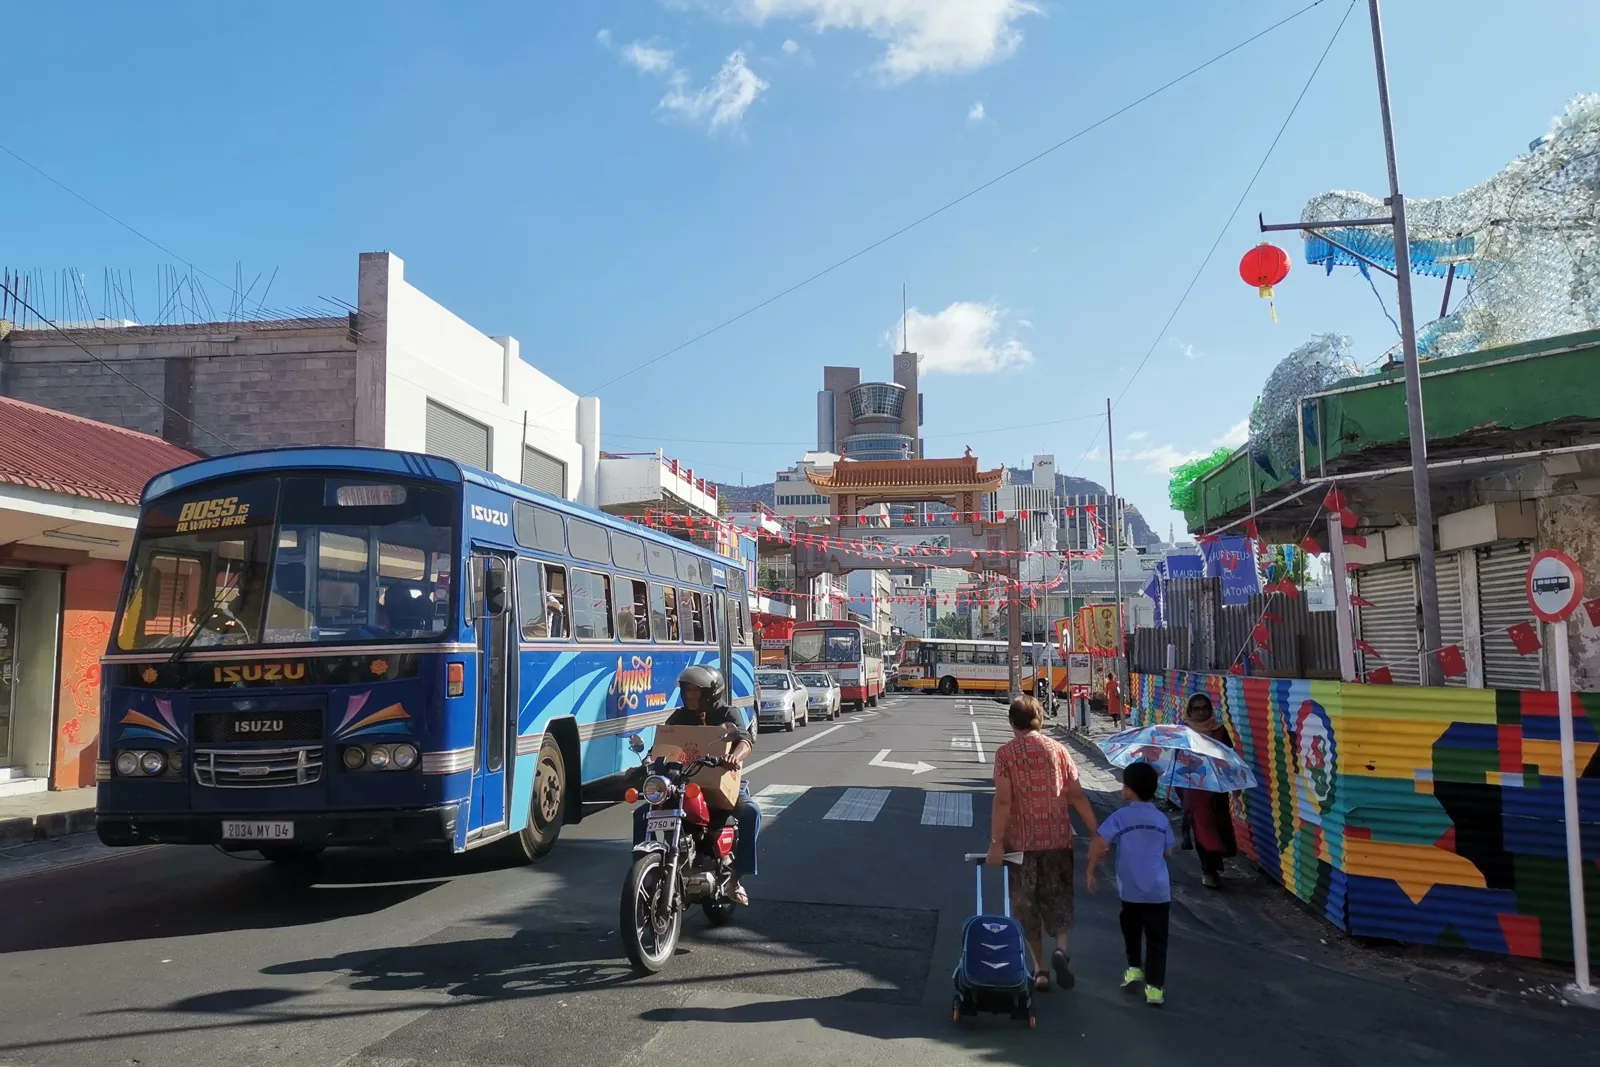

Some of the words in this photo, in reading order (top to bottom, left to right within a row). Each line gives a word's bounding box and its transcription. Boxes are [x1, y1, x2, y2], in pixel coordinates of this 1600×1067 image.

[178, 496, 239, 522] BOSS
[238, 503, 250, 514] IS
[470, 503, 509, 527] ISUZU
[175, 517, 221, 533] ALWAYS
[213, 663, 305, 684] ISUZU
[234, 719, 284, 733] ISUZU
[228, 823, 253, 837] 2034
[256, 823, 271, 837] MY
[274, 823, 289, 837] 04
[648, 820, 668, 829] 2750
